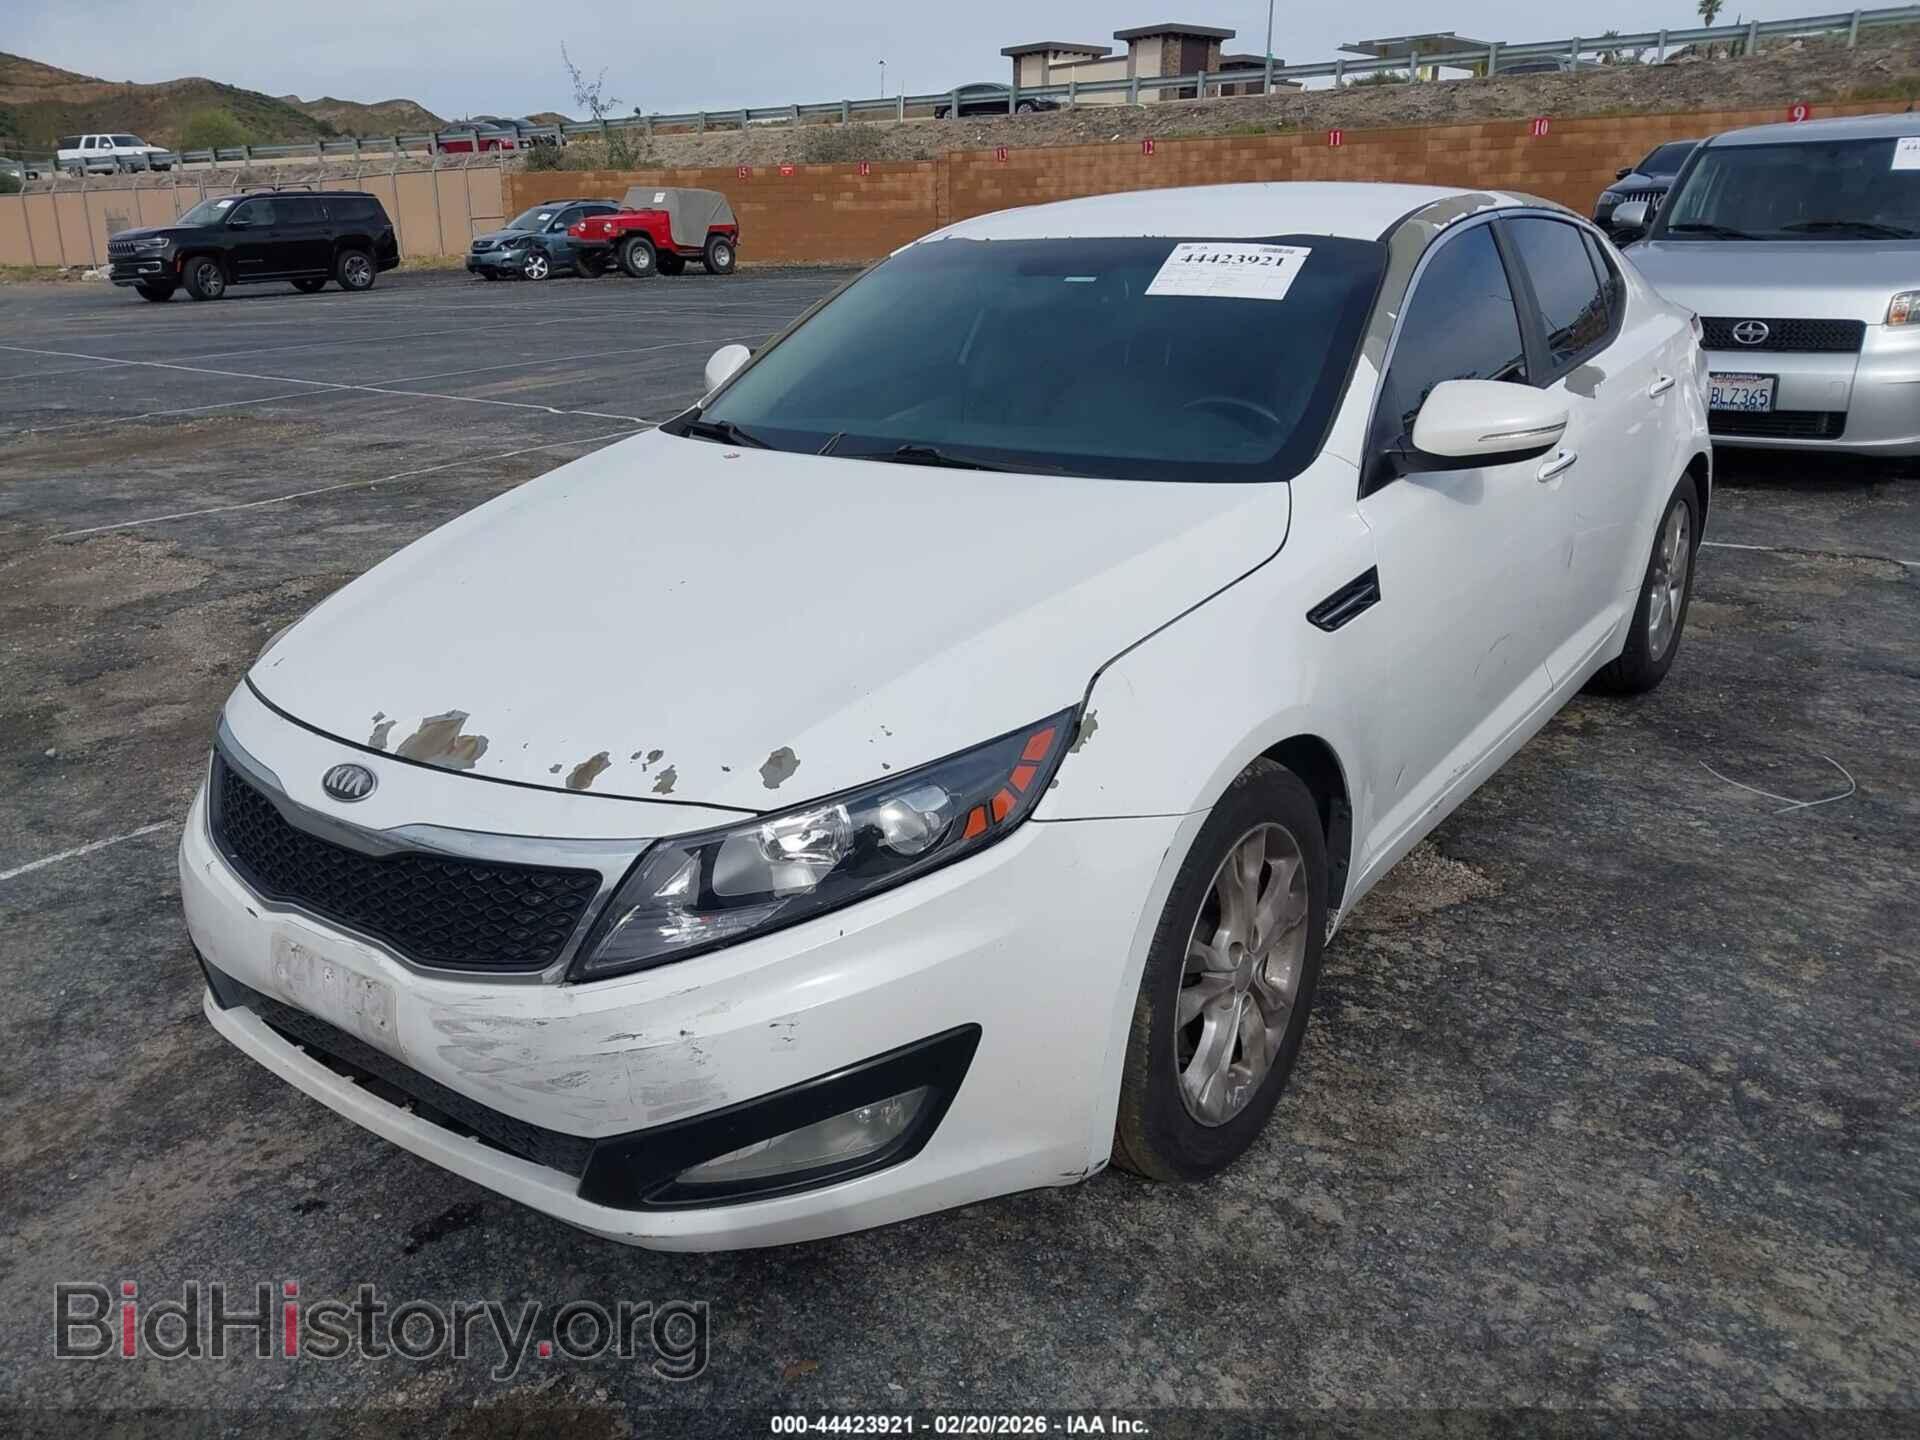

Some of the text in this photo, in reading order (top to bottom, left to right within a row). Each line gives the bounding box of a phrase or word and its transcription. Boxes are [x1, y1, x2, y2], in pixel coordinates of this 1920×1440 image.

[1793, 105, 1806, 123] 9
[1535, 119, 1548, 136] 10
[1329, 131, 1341, 146] 11
[999, 148, 1008, 161] 13
[1144, 140, 1153, 154] 12
[738, 167, 747, 178] 15
[1181, 252, 1286, 267] 44423921
[325, 766, 367, 796] KIA
